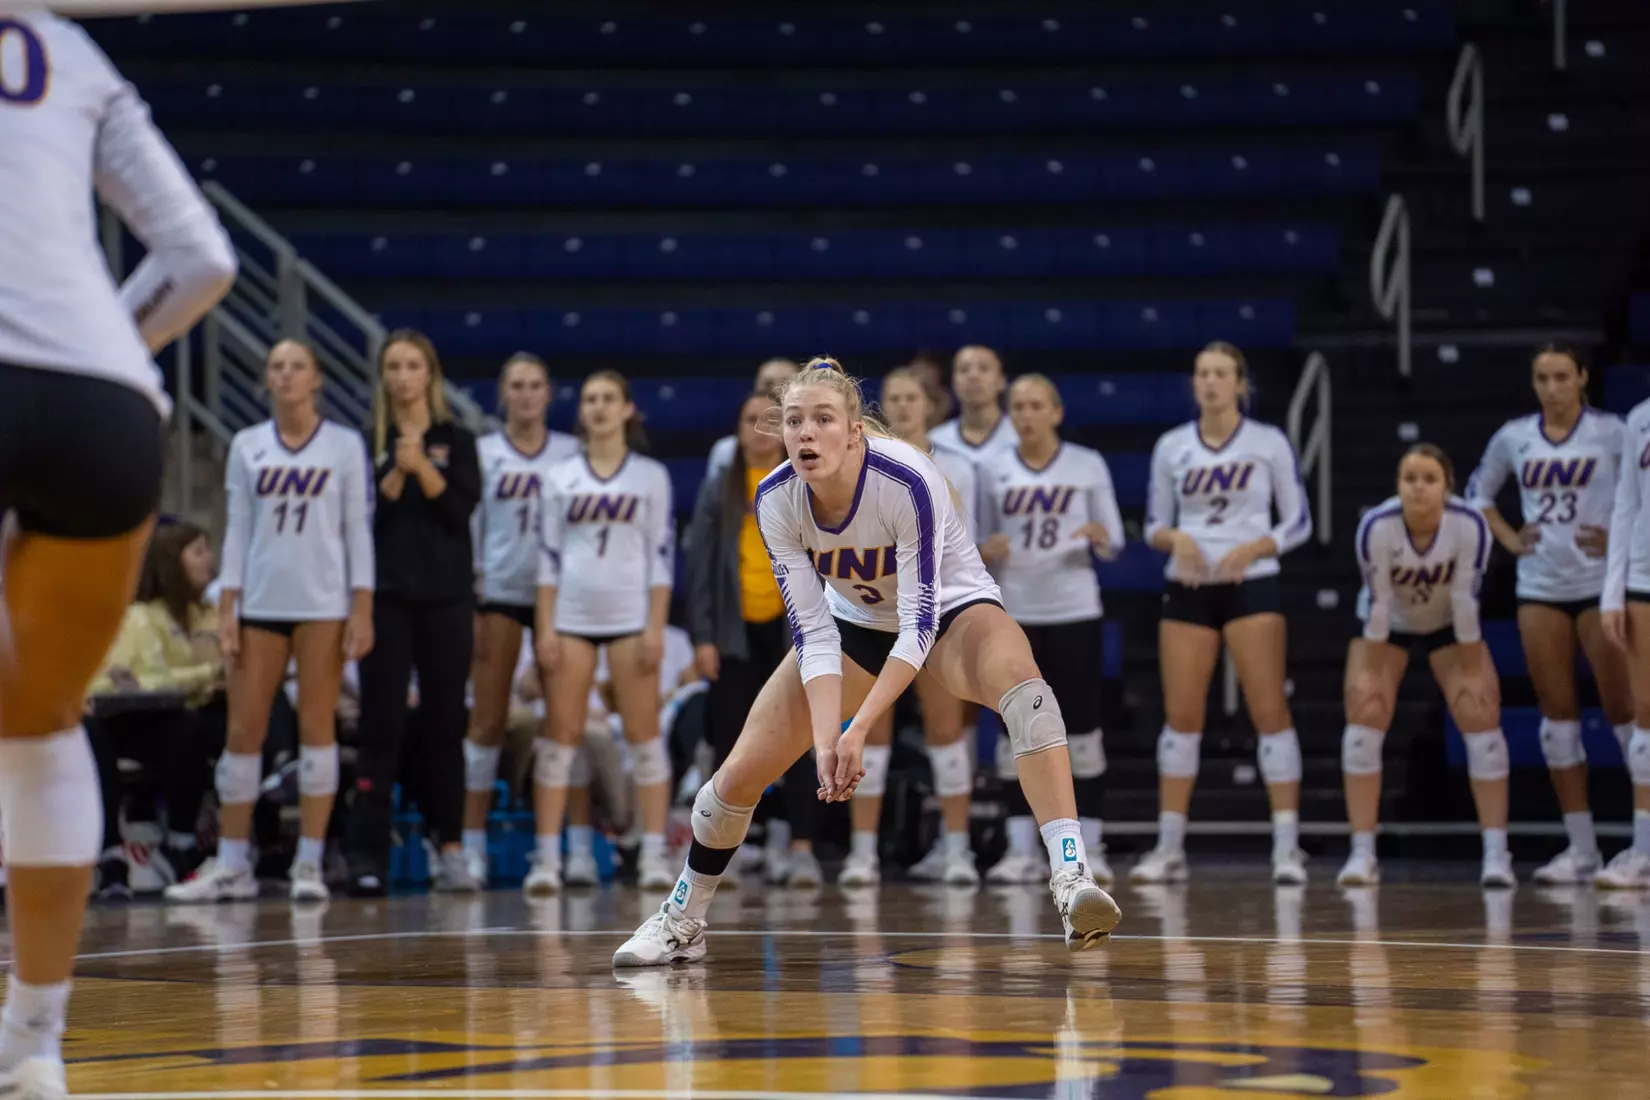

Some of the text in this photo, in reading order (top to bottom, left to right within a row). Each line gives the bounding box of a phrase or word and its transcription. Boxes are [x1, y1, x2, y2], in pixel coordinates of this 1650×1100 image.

[256, 465, 331, 499] UNI
[497, 472, 542, 502] UN
[1181, 462, 1256, 497] UNI
[1521, 456, 1597, 490] UNI
[272, 500, 310, 535] 11
[566, 493, 640, 525] UNI
[1003, 485, 1077, 517] UNI
[1205, 495, 1231, 527] 2
[1538, 490, 1579, 525] 23
[595, 526, 611, 558] 1
[1020, 516, 1061, 550] 18
[806, 543, 898, 583] UNI
[1389, 556, 1458, 589] UNI
[852, 584, 886, 606] 3
